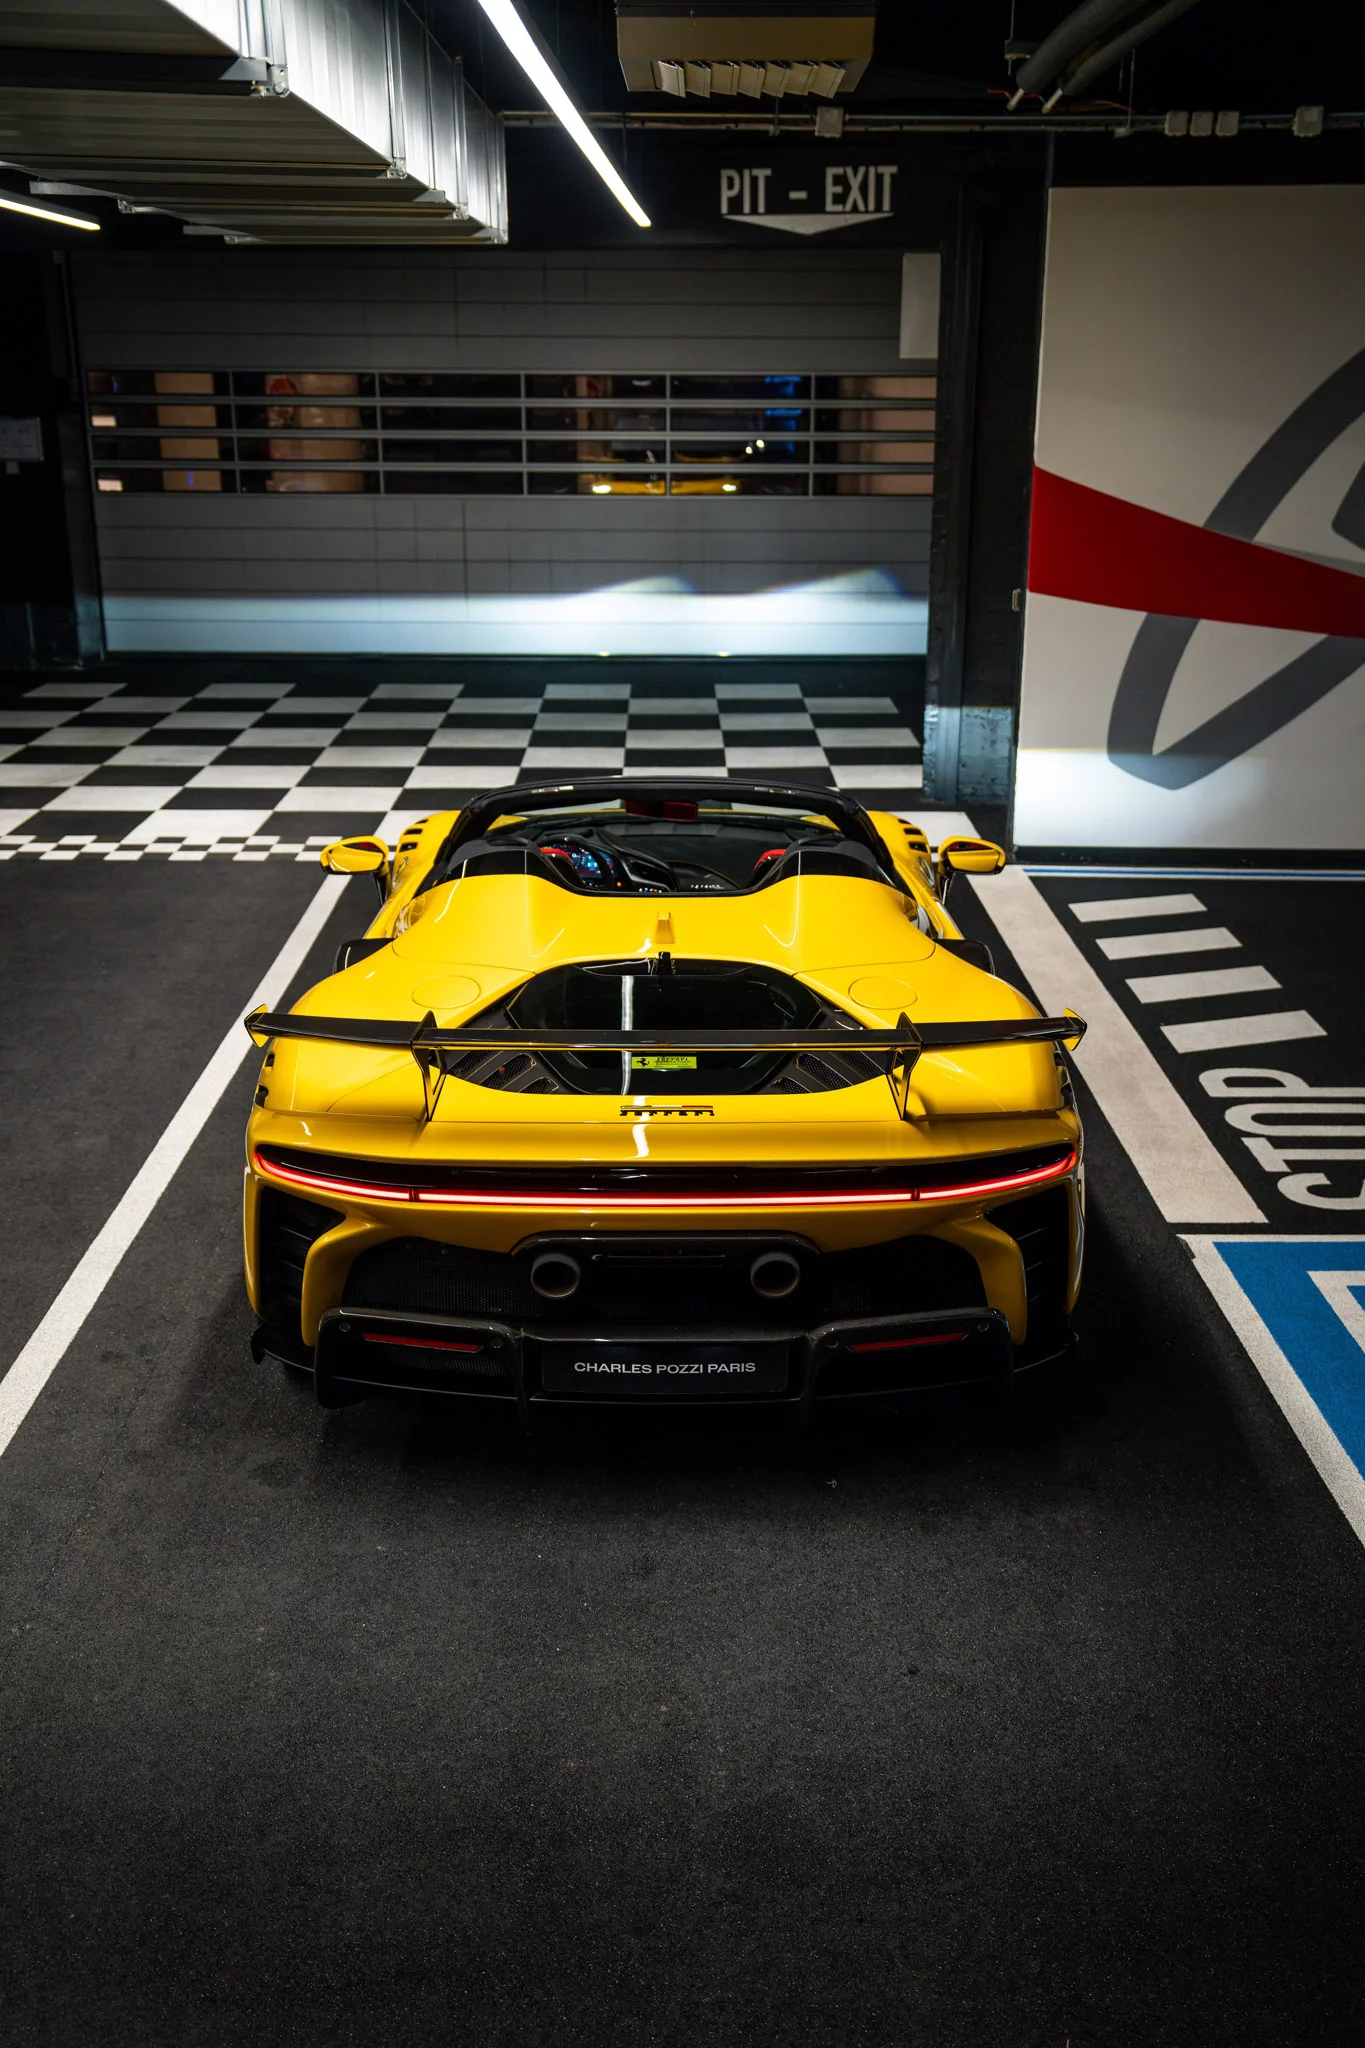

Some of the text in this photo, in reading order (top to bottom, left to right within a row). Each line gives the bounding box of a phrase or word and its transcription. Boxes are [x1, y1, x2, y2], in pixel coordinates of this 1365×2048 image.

[720, 168, 772, 214] PIT
[825, 165, 898, 212] EXIT
[574, 1362, 756, 1374] CHARLES POZZI PARIS
